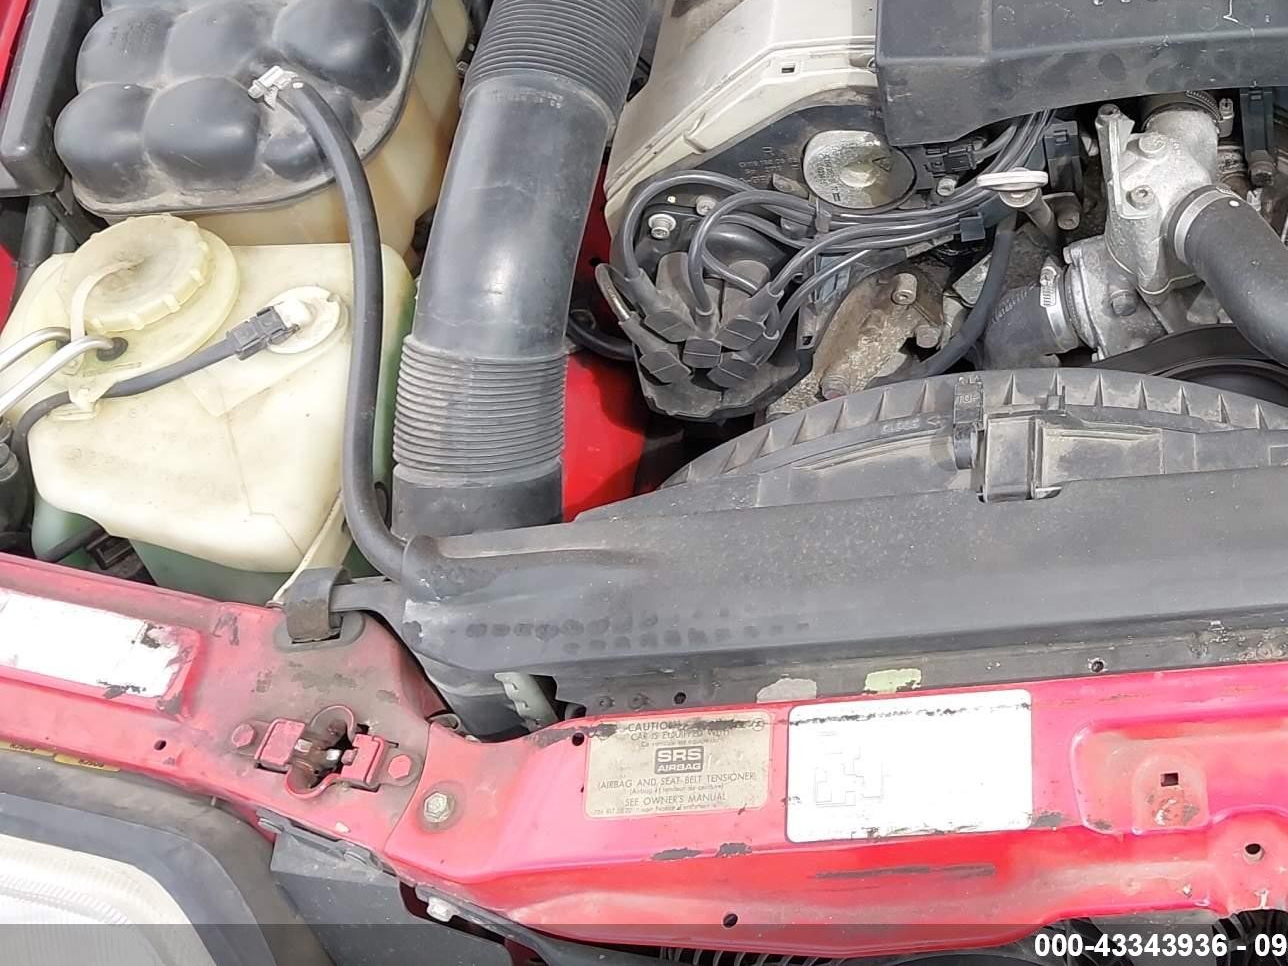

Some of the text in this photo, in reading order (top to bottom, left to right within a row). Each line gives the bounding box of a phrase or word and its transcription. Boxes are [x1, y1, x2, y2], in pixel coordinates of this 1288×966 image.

[657, 748, 702, 763] SRS
[657, 763, 702, 772] AIRBAG
[637, 778, 657, 787] AND
[660, 776, 681, 786] SEAT
[685, 775, 702, 784] BELT
[625, 792, 726, 807] SEE OWNER'S MANUAL
